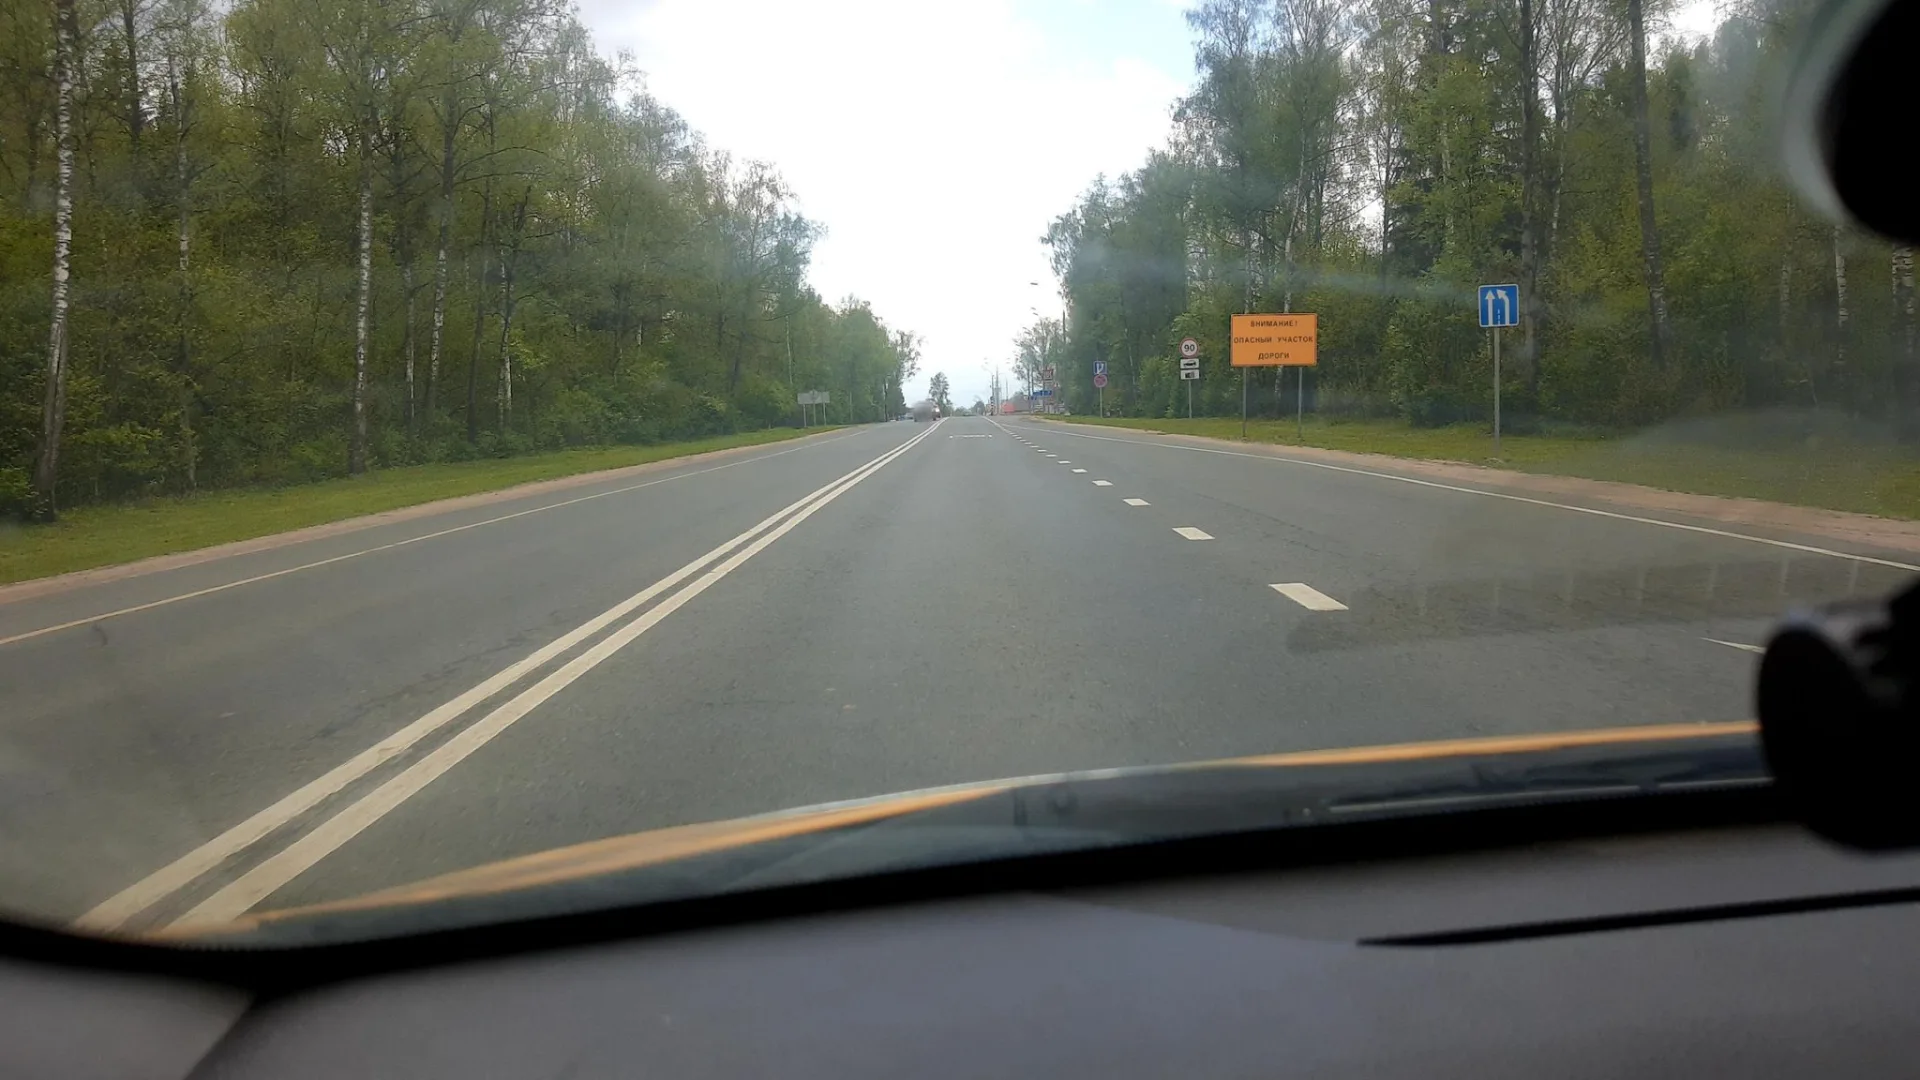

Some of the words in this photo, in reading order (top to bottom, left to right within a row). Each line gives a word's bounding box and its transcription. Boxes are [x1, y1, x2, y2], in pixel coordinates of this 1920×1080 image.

[1277, 335, 1314, 343] УЧАСТОК
[1184, 344, 1195, 352] 90
[1257, 352, 1290, 360] ДОРОГИ
